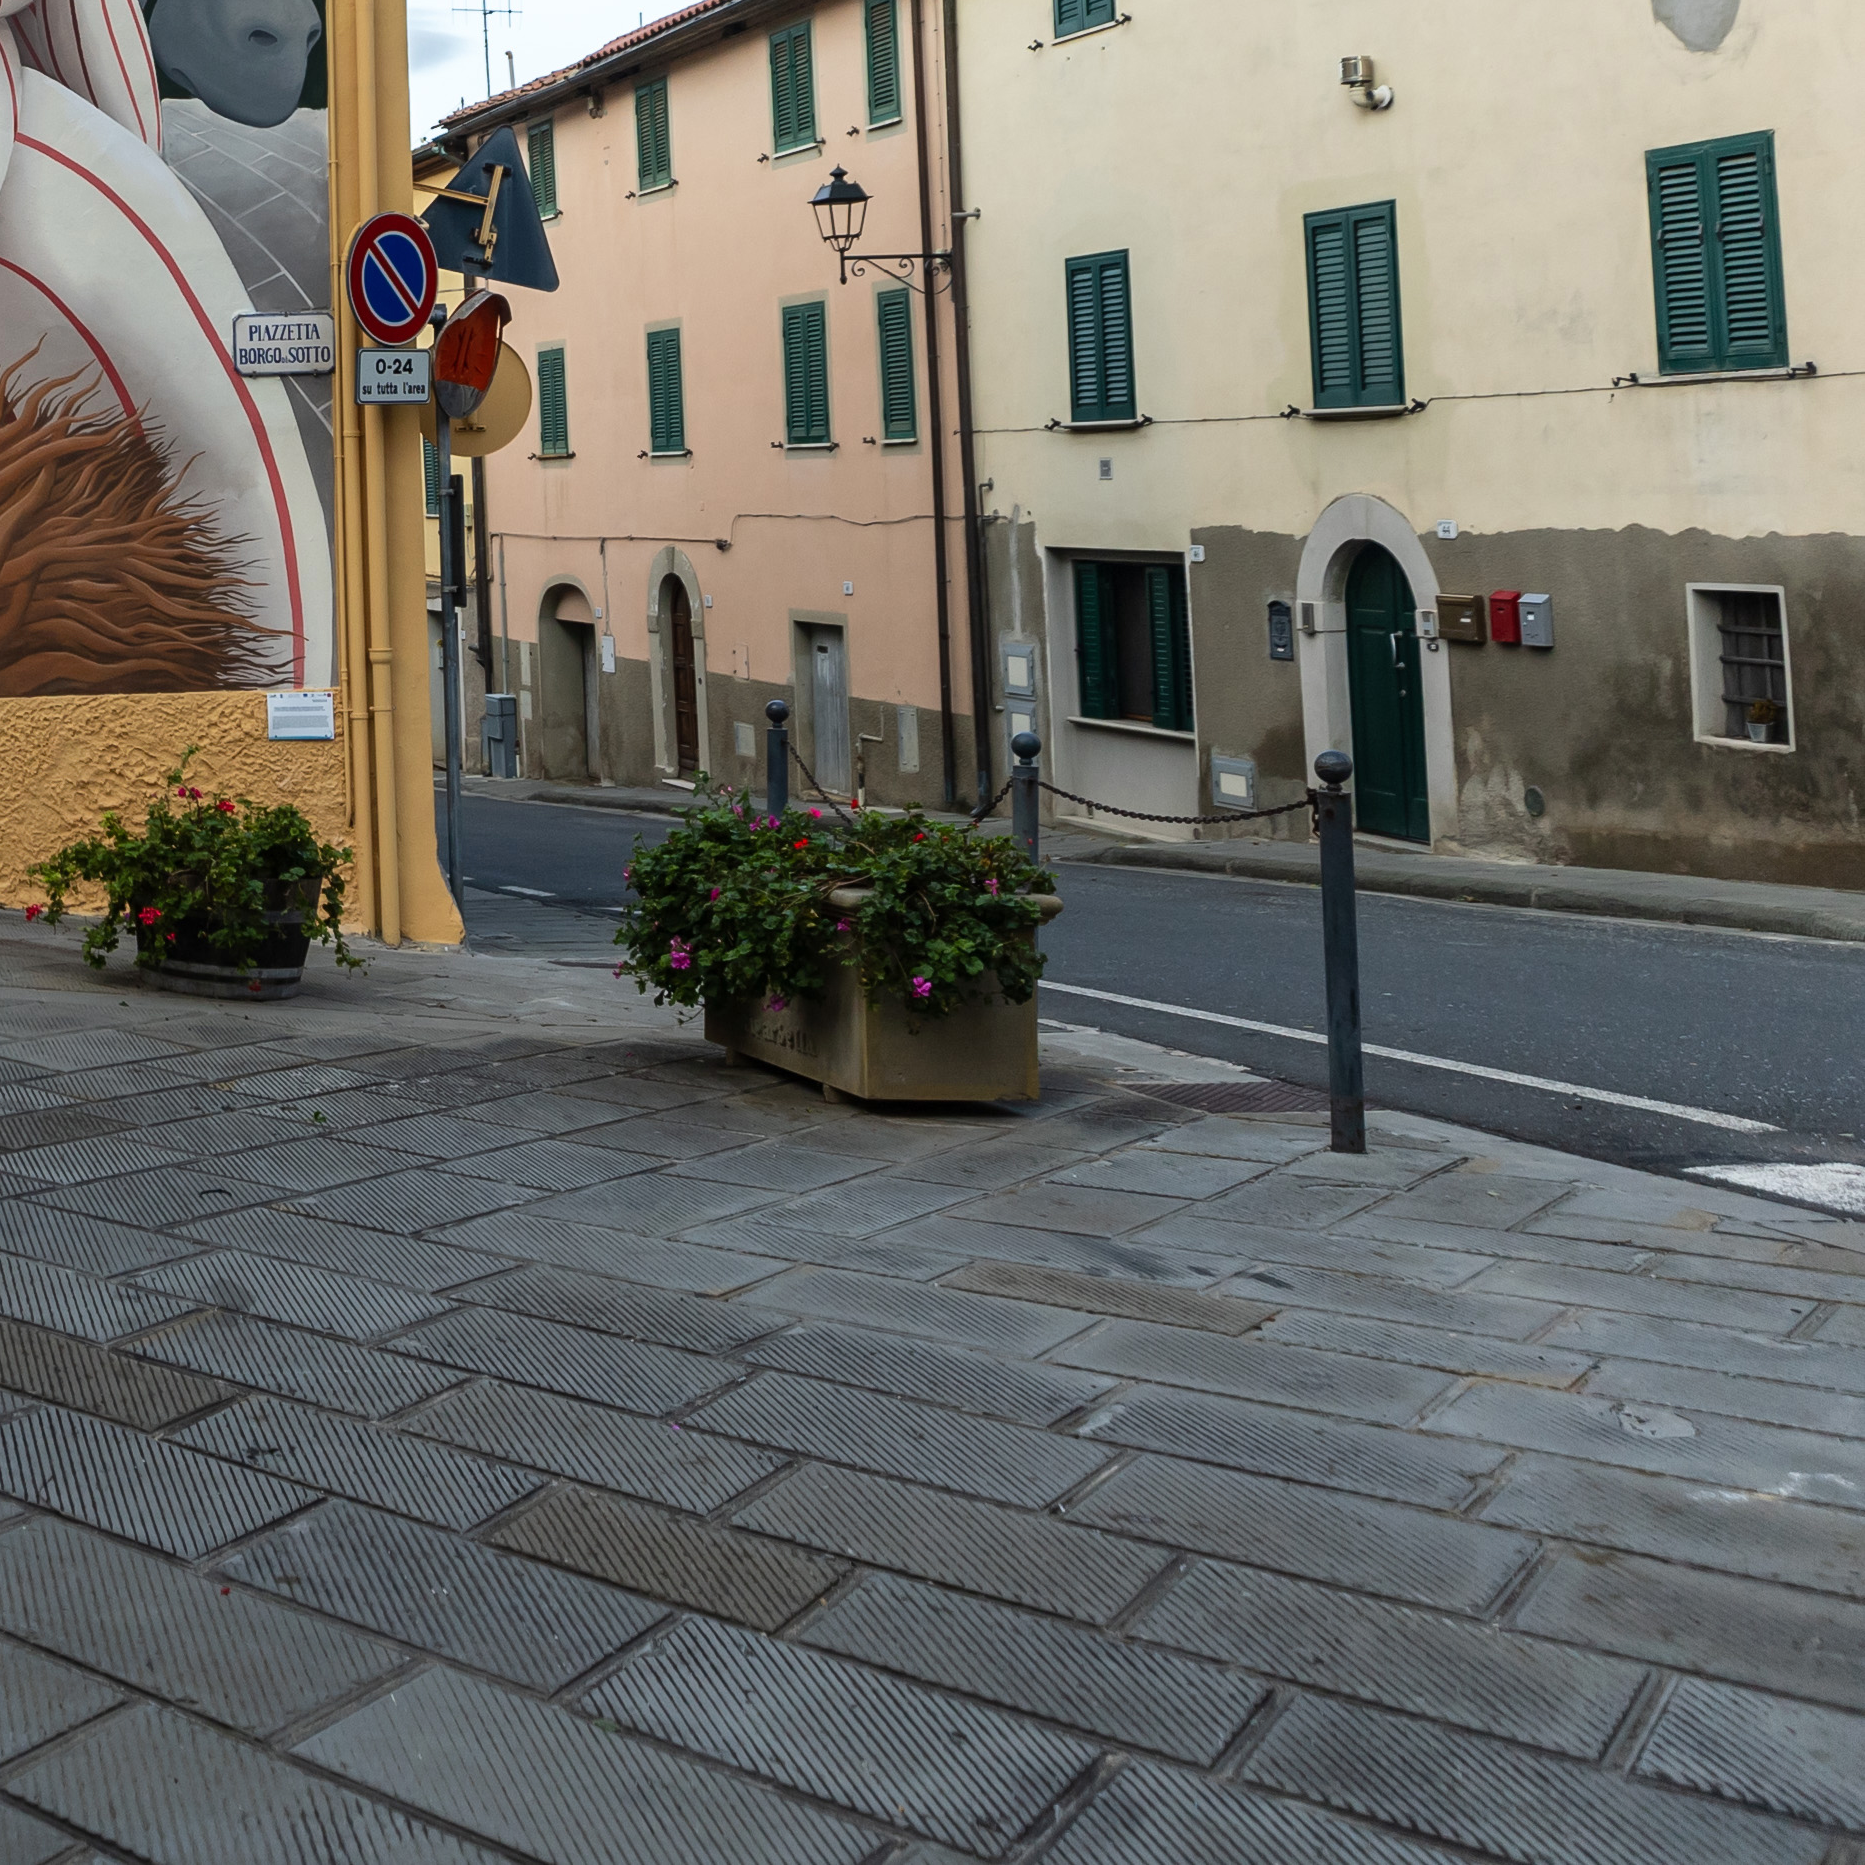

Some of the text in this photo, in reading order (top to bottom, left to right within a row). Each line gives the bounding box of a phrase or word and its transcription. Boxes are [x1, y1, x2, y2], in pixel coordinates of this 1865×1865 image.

[249, 323, 320, 342] PIAZZETTA
[239, 347, 282, 365] BORGO
[288, 345, 331, 364] SOTTO
[375, 358, 413, 375] 0-24
[362, 382, 426, 395] su tutta l'area
